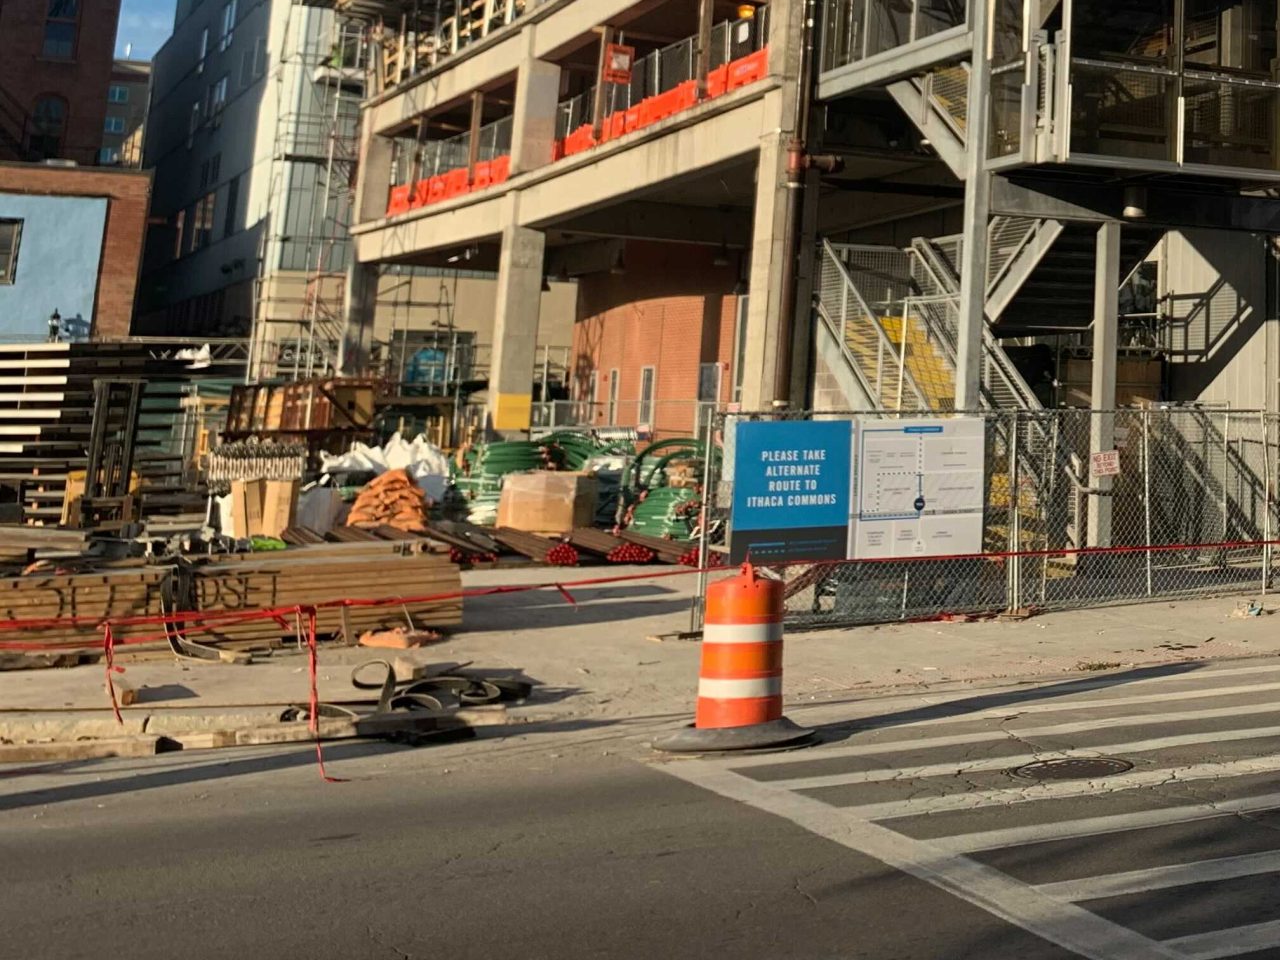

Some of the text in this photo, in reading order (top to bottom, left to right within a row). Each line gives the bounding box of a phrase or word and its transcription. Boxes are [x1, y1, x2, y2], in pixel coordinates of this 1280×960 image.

[761, 449, 827, 462] PLEASE TAKE
[765, 465, 821, 477] ALTERNATE
[768, 479, 817, 492] ROUTE TO
[746, 494, 837, 508] ITHACA COMMONS
